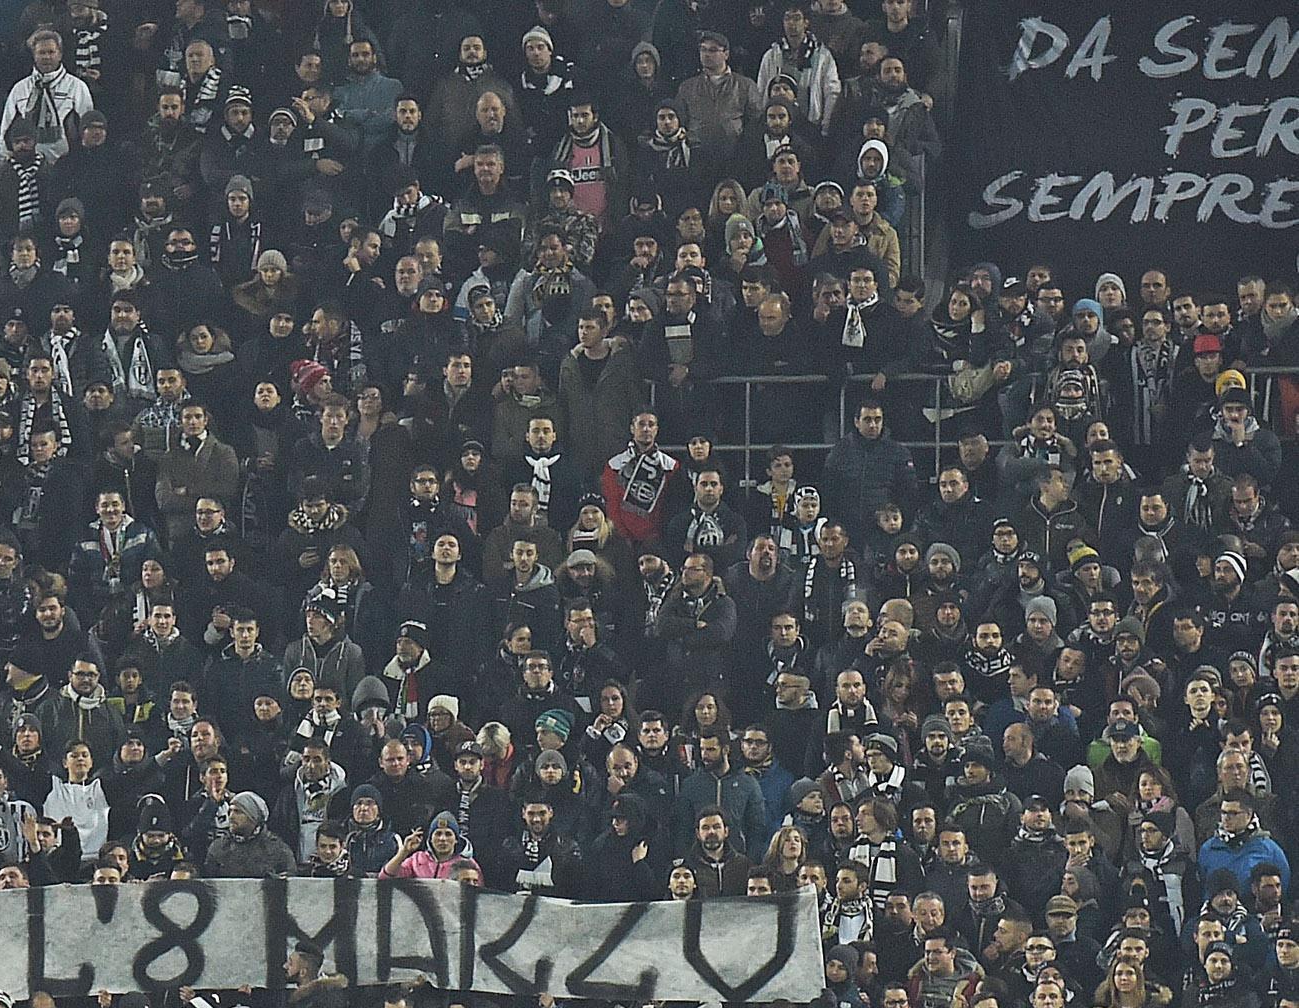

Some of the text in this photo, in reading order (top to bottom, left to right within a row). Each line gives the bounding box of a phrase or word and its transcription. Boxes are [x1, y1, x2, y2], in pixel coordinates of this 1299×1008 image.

[1004, 14, 1117, 81] DA
[1160, 93, 1299, 158] PER
[574, 169, 598, 182] Jee
[968, 168, 1299, 228] SEMPRE
